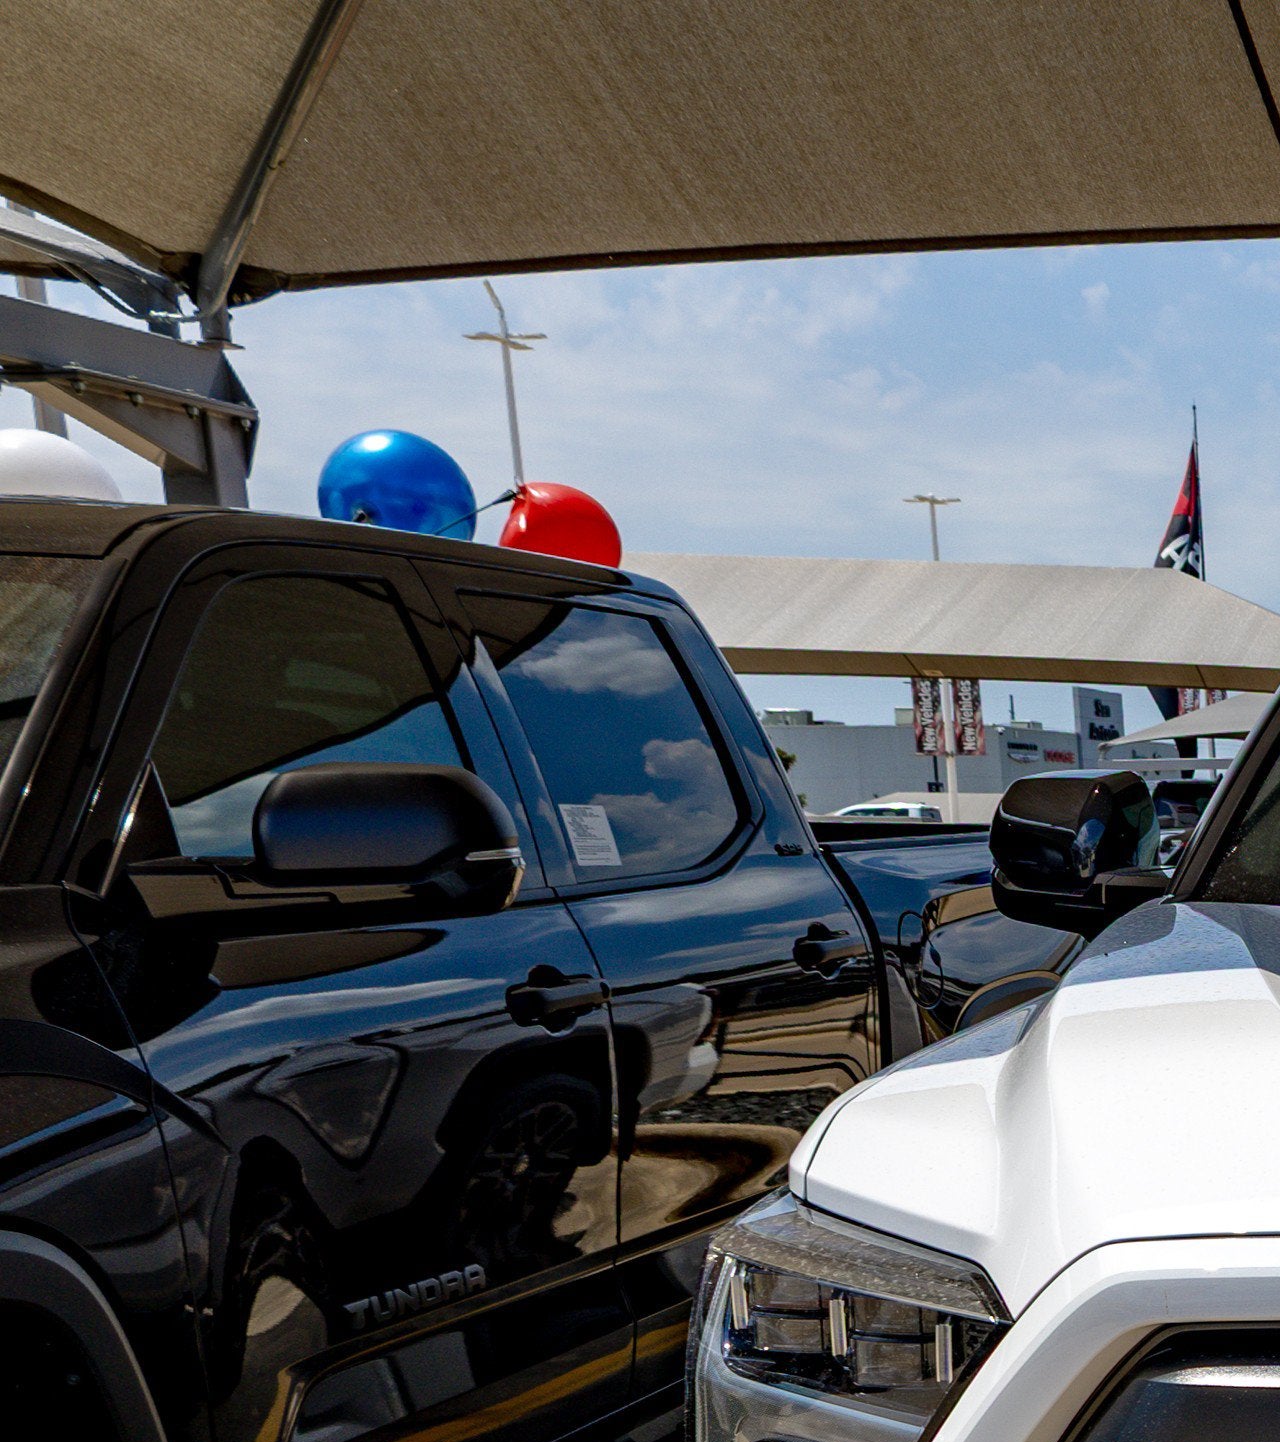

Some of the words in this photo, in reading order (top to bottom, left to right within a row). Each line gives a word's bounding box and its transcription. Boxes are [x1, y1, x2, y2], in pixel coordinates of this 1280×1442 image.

[918, 680, 934, 725] Vehicles
[958, 680, 974, 725] Vehicles
[923, 727, 937, 751] New
[962, 727, 977, 751] New
[343, 1264, 487, 1330] TUNDRA
